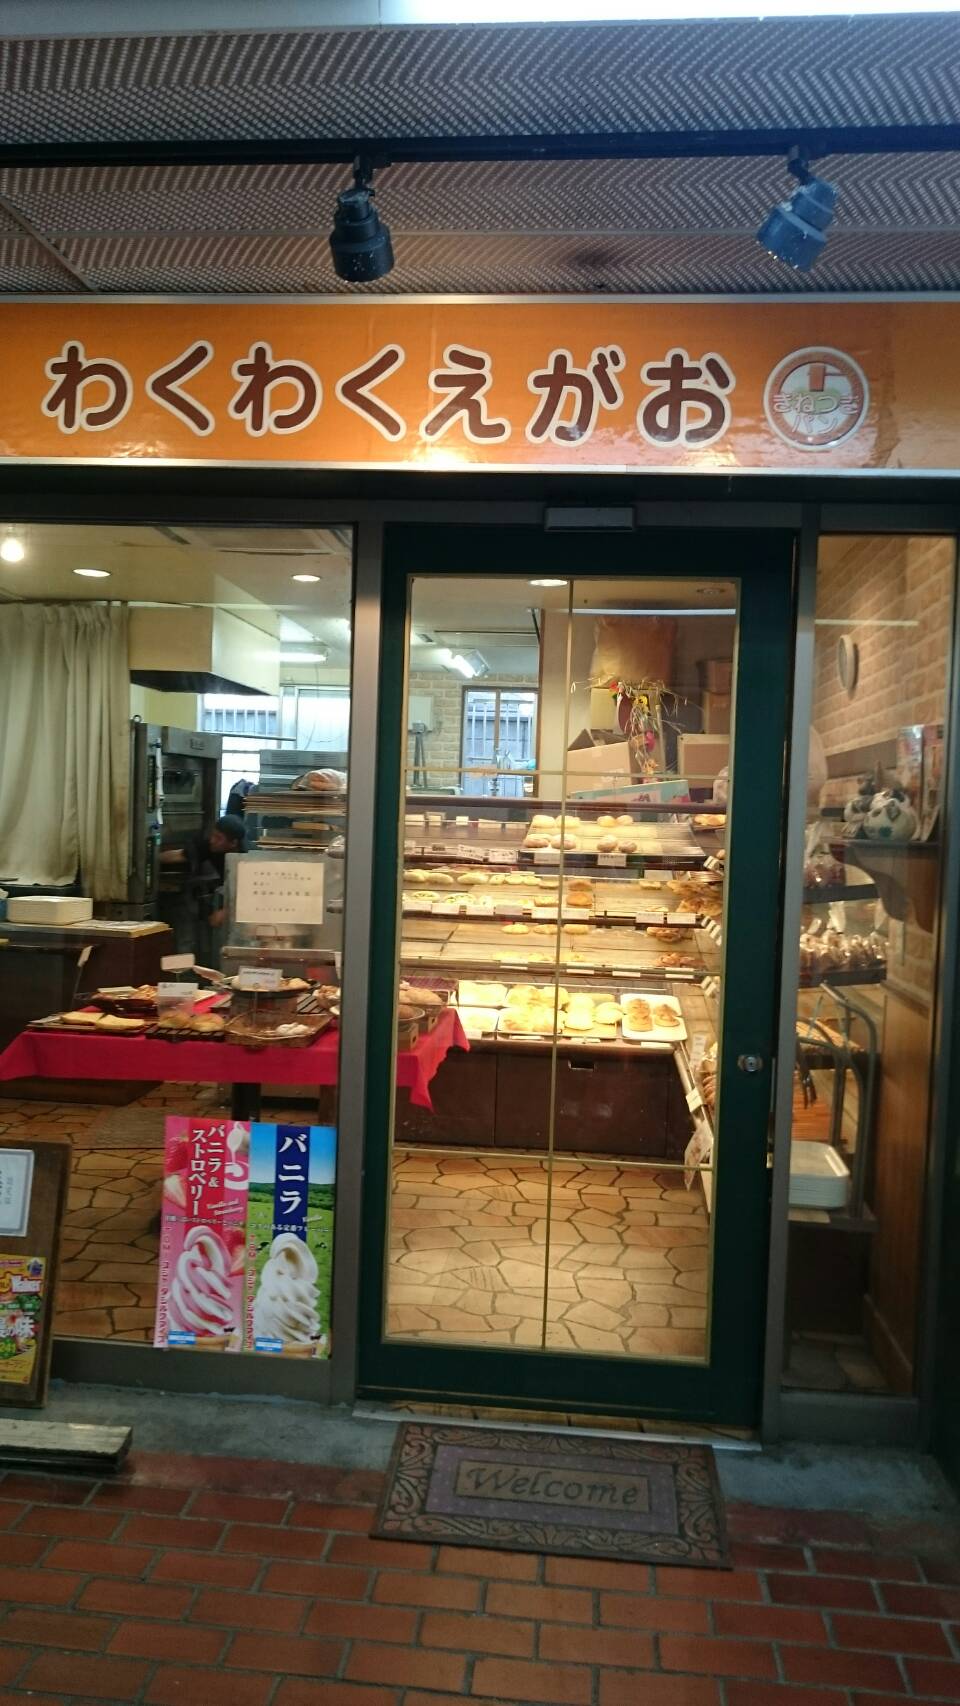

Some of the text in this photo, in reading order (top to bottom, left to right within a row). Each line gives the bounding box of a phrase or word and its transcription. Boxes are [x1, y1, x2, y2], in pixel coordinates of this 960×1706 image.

[42, 339, 737, 449] わくわくえがお
[791, 414, 839, 434] パン
[188, 1129, 208, 1216] ストロベリー
[278, 1133, 308, 1215] バニラ
[466, 1467, 639, 1505] Welcome
